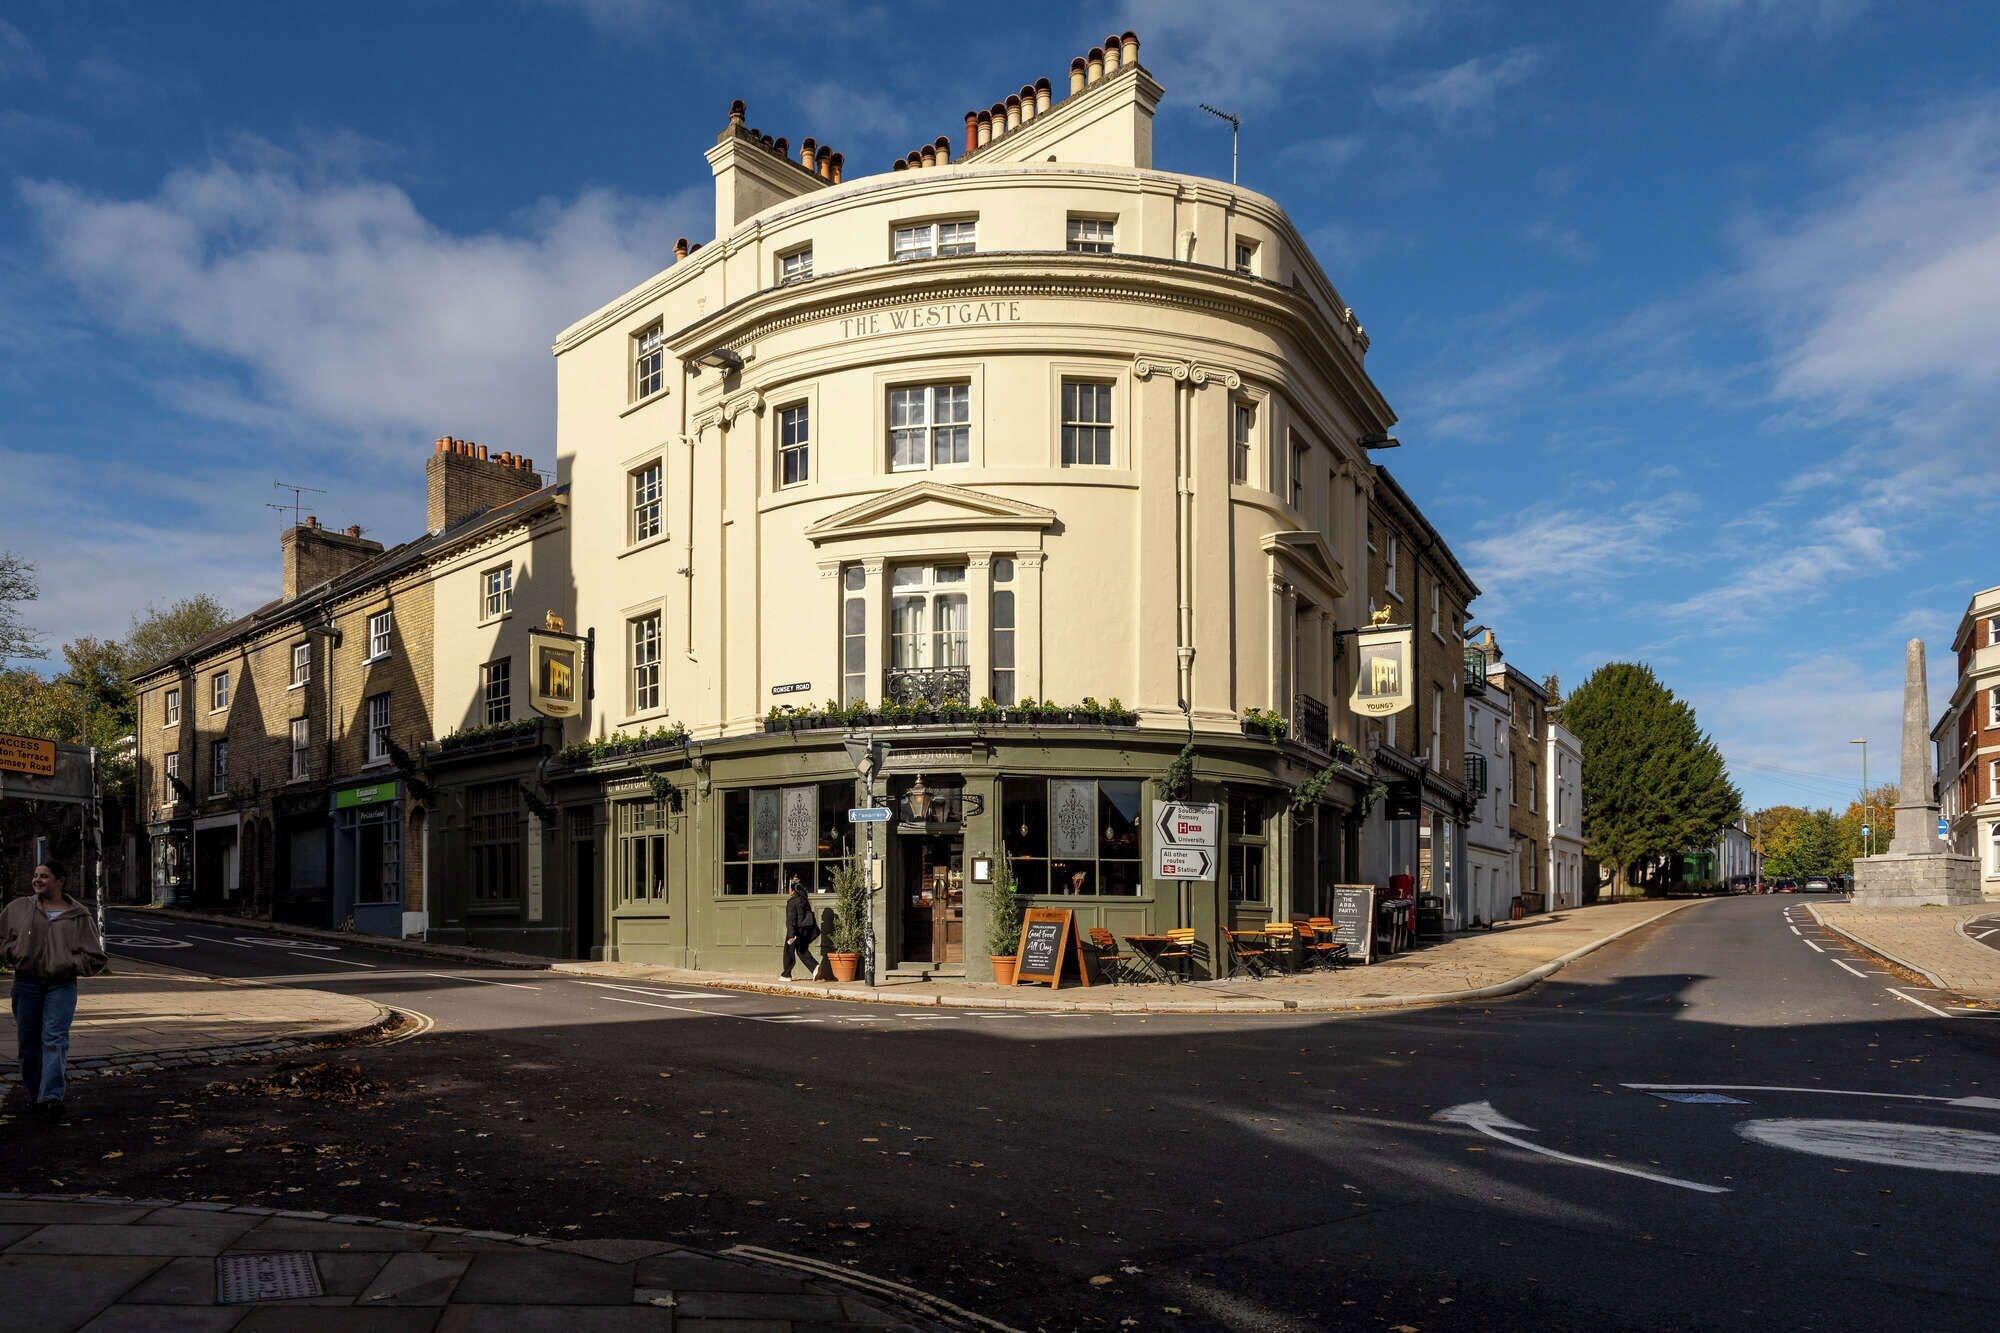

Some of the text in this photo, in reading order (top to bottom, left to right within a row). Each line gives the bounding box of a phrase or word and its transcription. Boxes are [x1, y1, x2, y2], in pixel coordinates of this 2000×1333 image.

[840, 301, 1021, 338] THE WESTGATE
[773, 683, 809, 693] ROMSEY ROAD
[0, 738, 39, 750] ACCESS
[18, 750, 49, 761] Terrace
[30, 762, 51, 771] Road
